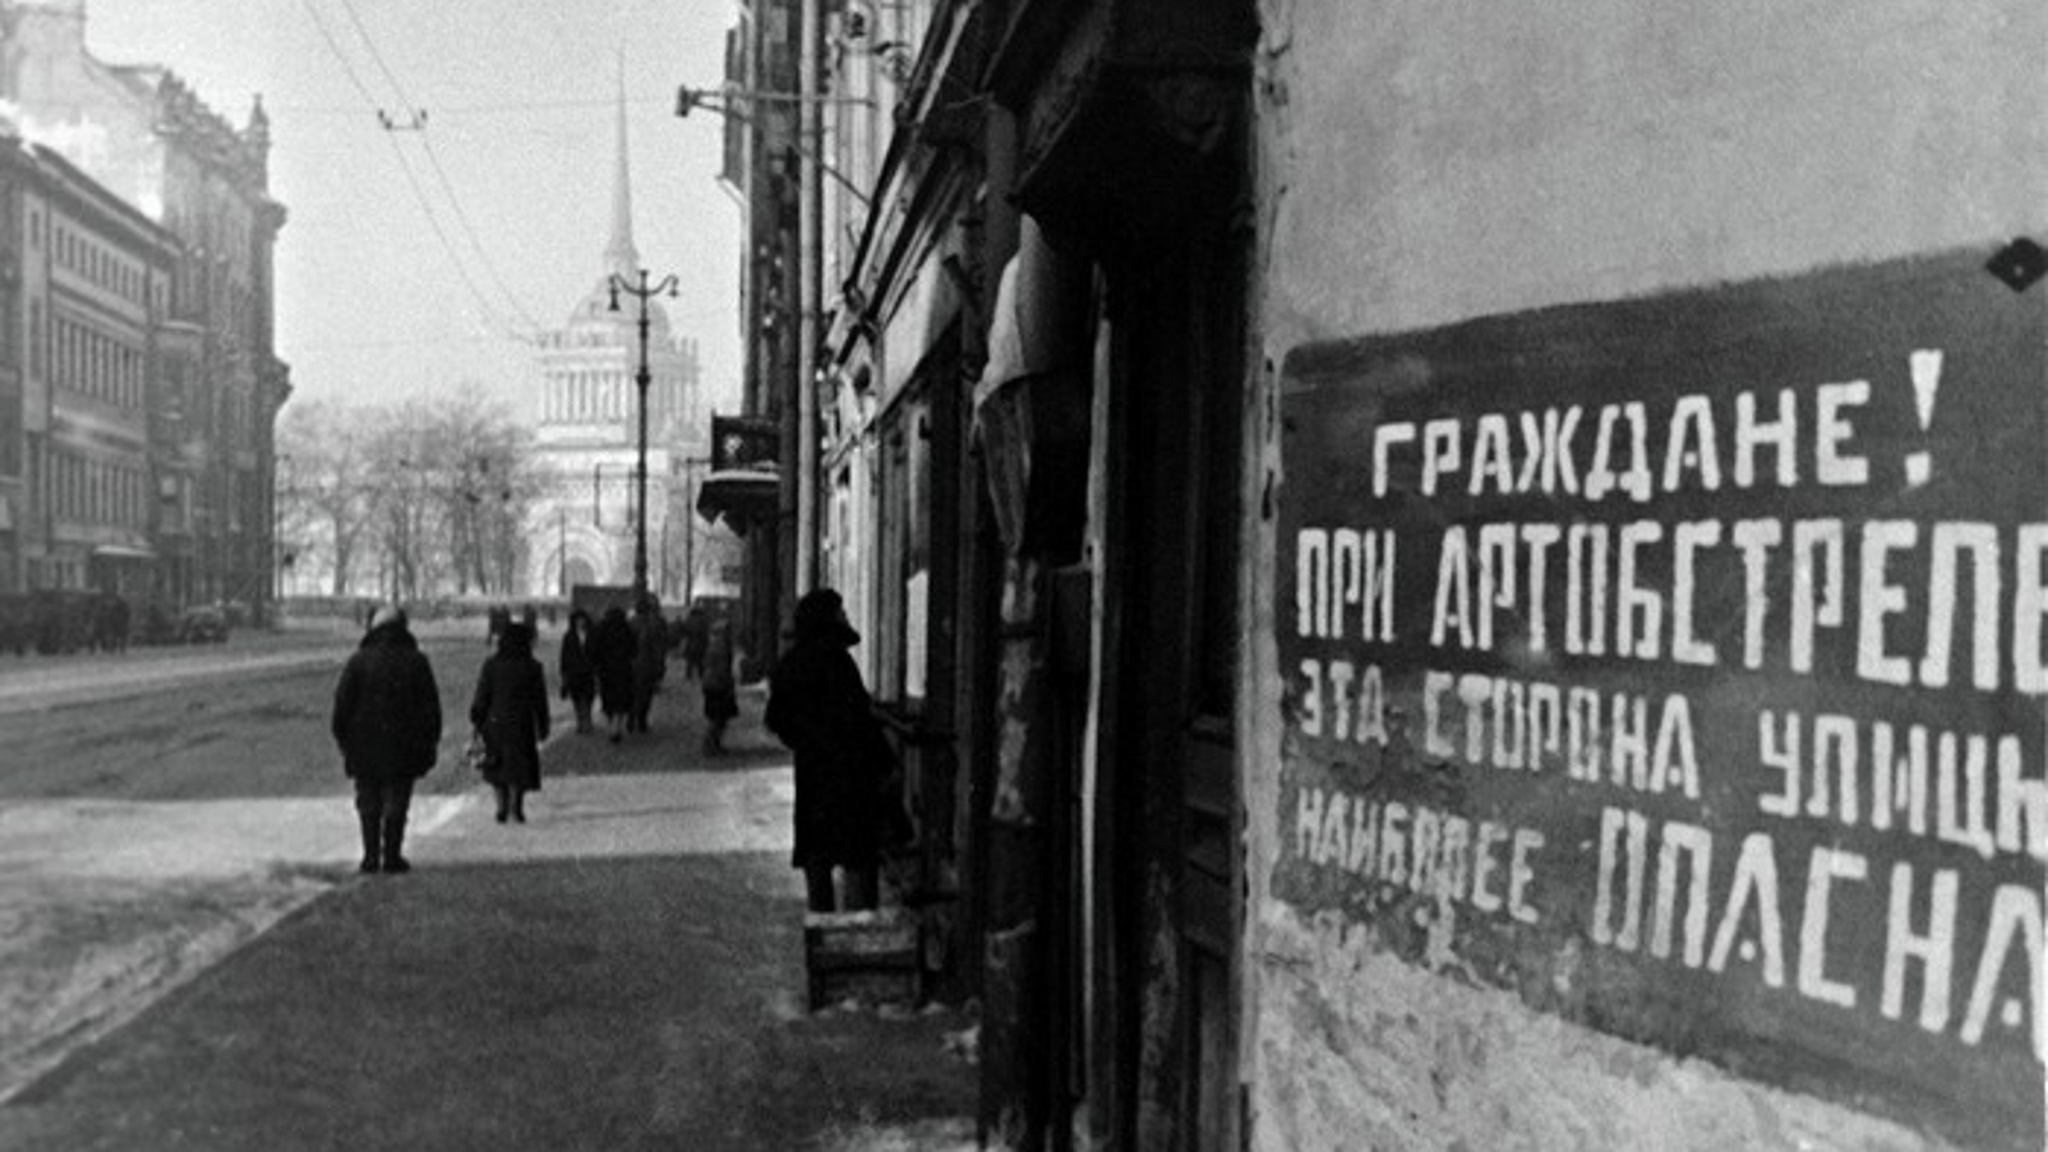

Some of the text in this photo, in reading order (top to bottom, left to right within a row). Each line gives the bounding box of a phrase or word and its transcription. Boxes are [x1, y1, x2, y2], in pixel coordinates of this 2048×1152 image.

[1297, 528, 1396, 643] ПРИ
[1300, 659, 1389, 747] ЭТА
[1424, 671, 1700, 798] СТОРОНА
[1592, 806, 2048, 1066] ОПАСНА
